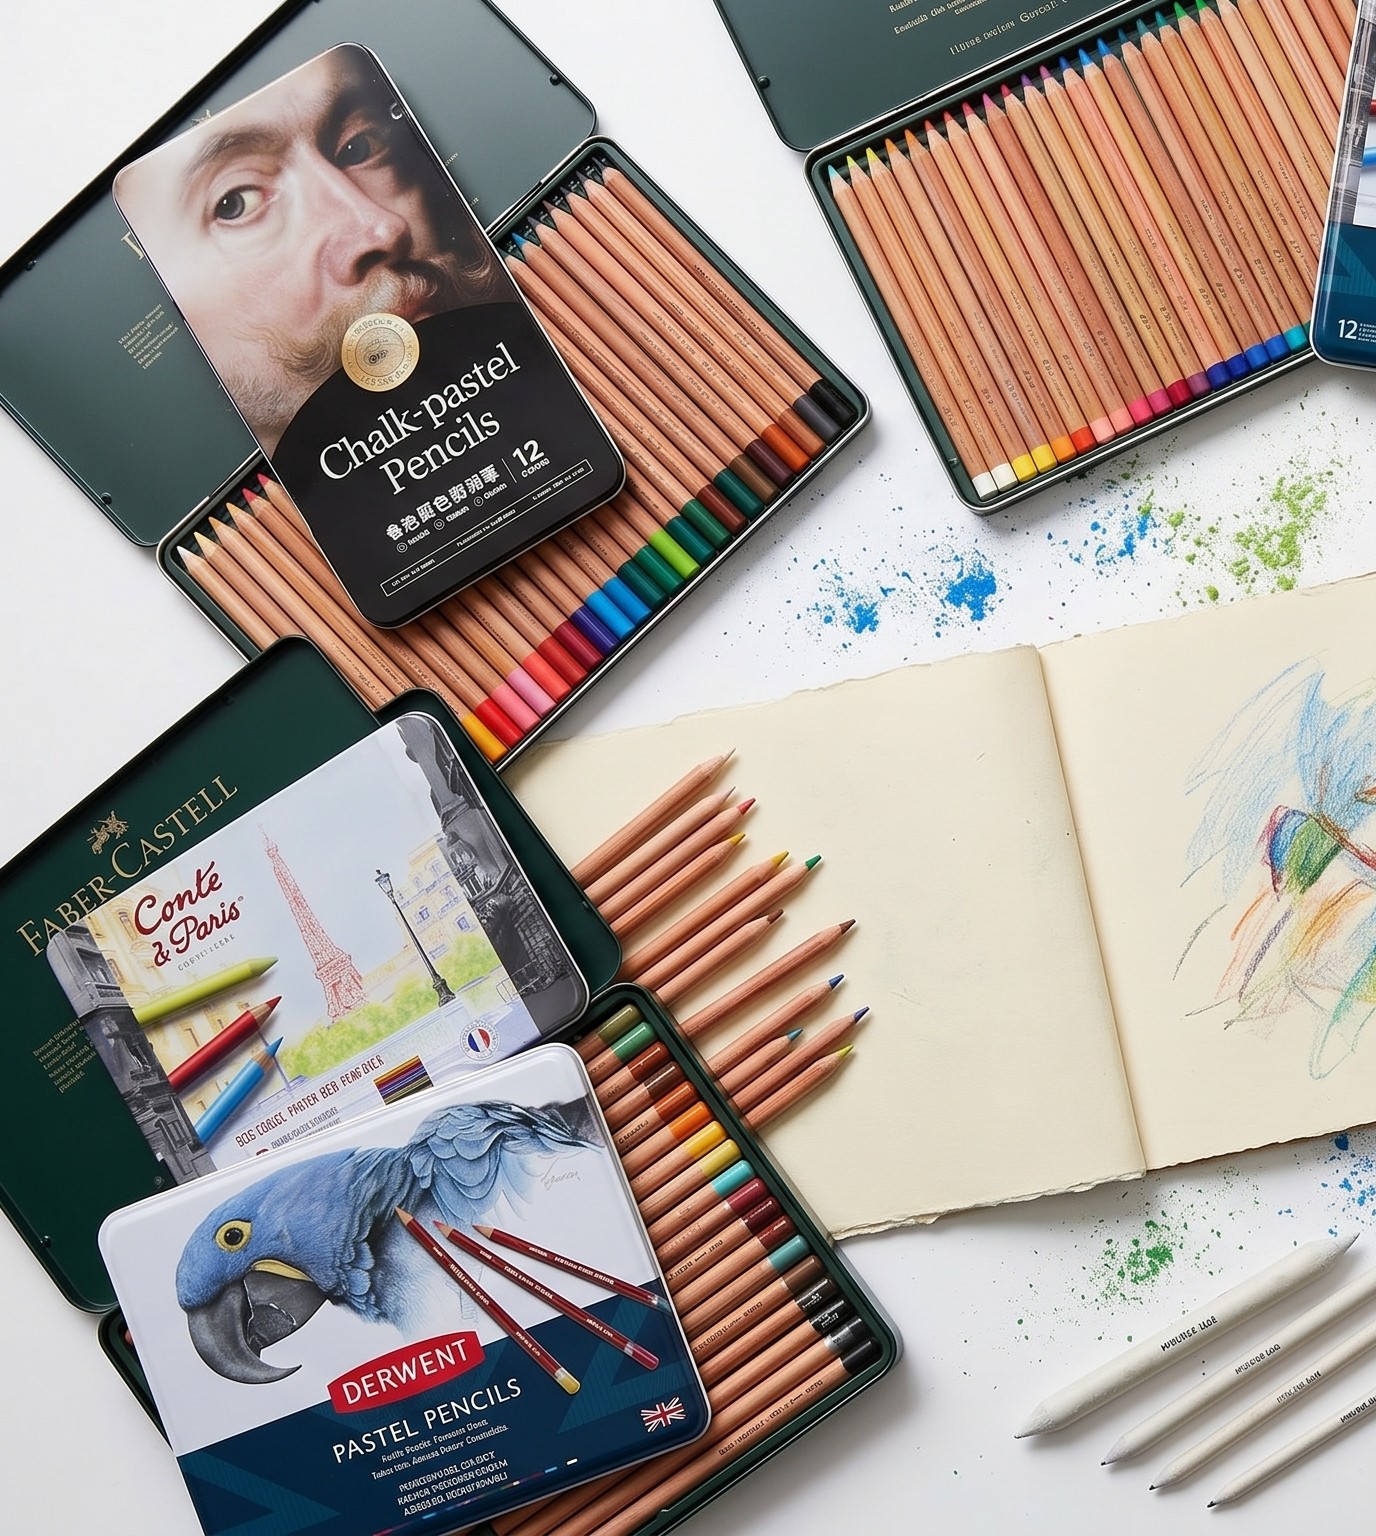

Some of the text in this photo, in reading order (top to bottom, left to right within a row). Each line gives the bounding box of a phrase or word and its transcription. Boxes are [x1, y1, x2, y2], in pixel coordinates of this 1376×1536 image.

[1338, 319, 1357, 340] 12
[319, 342, 521, 480] Chalk-pastel
[379, 411, 500, 495] Pencils
[512, 439, 545, 467] 12
[16, 775, 238, 958] FABER-CASTELL
[170, 902, 240, 954] Paris
[342, 1338, 467, 1405] DERWENT
[332, 1419, 419, 1464] PASTEL
[423, 1378, 522, 1430] PENCILS
